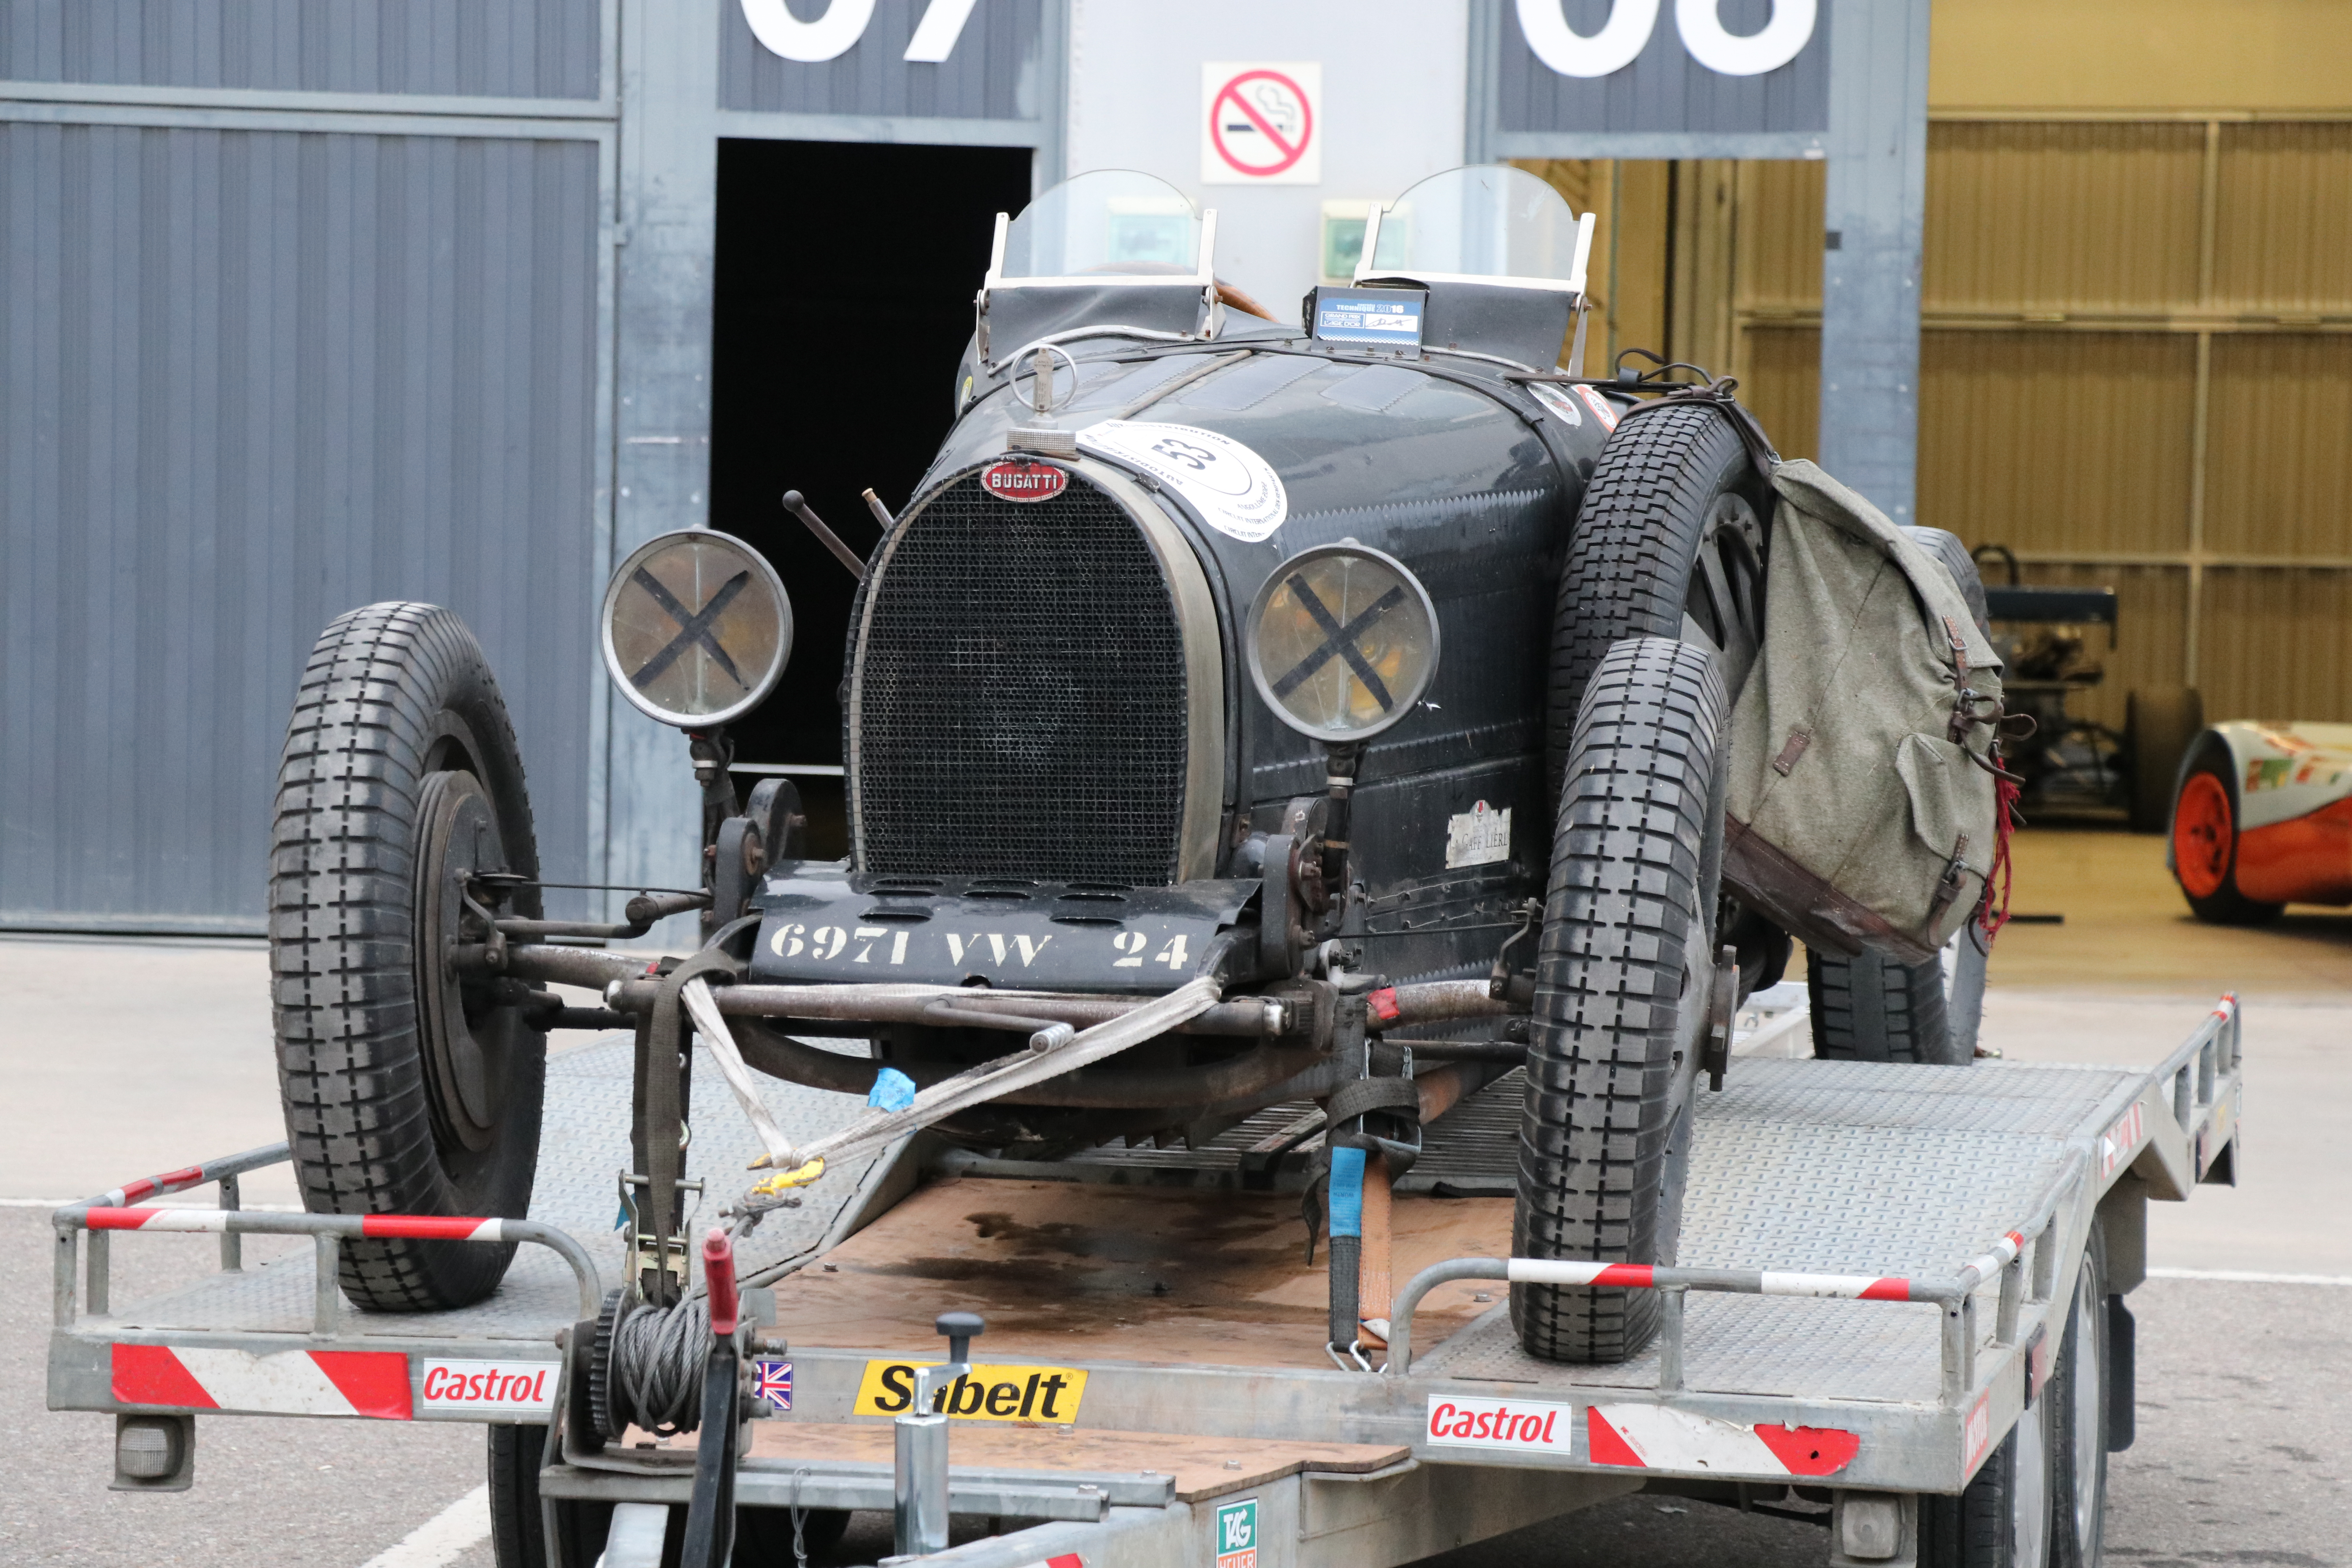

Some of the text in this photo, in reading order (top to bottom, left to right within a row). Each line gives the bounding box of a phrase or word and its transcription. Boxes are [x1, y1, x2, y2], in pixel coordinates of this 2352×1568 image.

[1376, 304, 1404, 313] 2016
[1151, 438, 1216, 470] 53
[991, 473, 1058, 490] BUGATTI
[1237, 496, 1267, 510] ANGOULÊME
[1218, 507, 1244, 522] CIRCUIT
[1245, 508, 1279, 524] INTERNATIONAL
[1224, 525, 1246, 537] CIRCUIT
[770, 923, 1189, 970] 6971 VW 24
[423, 1366, 546, 1403] Castrol
[1430, 1403, 1557, 1443] Castrol
[1223, 1508, 1252, 1550] TAG
